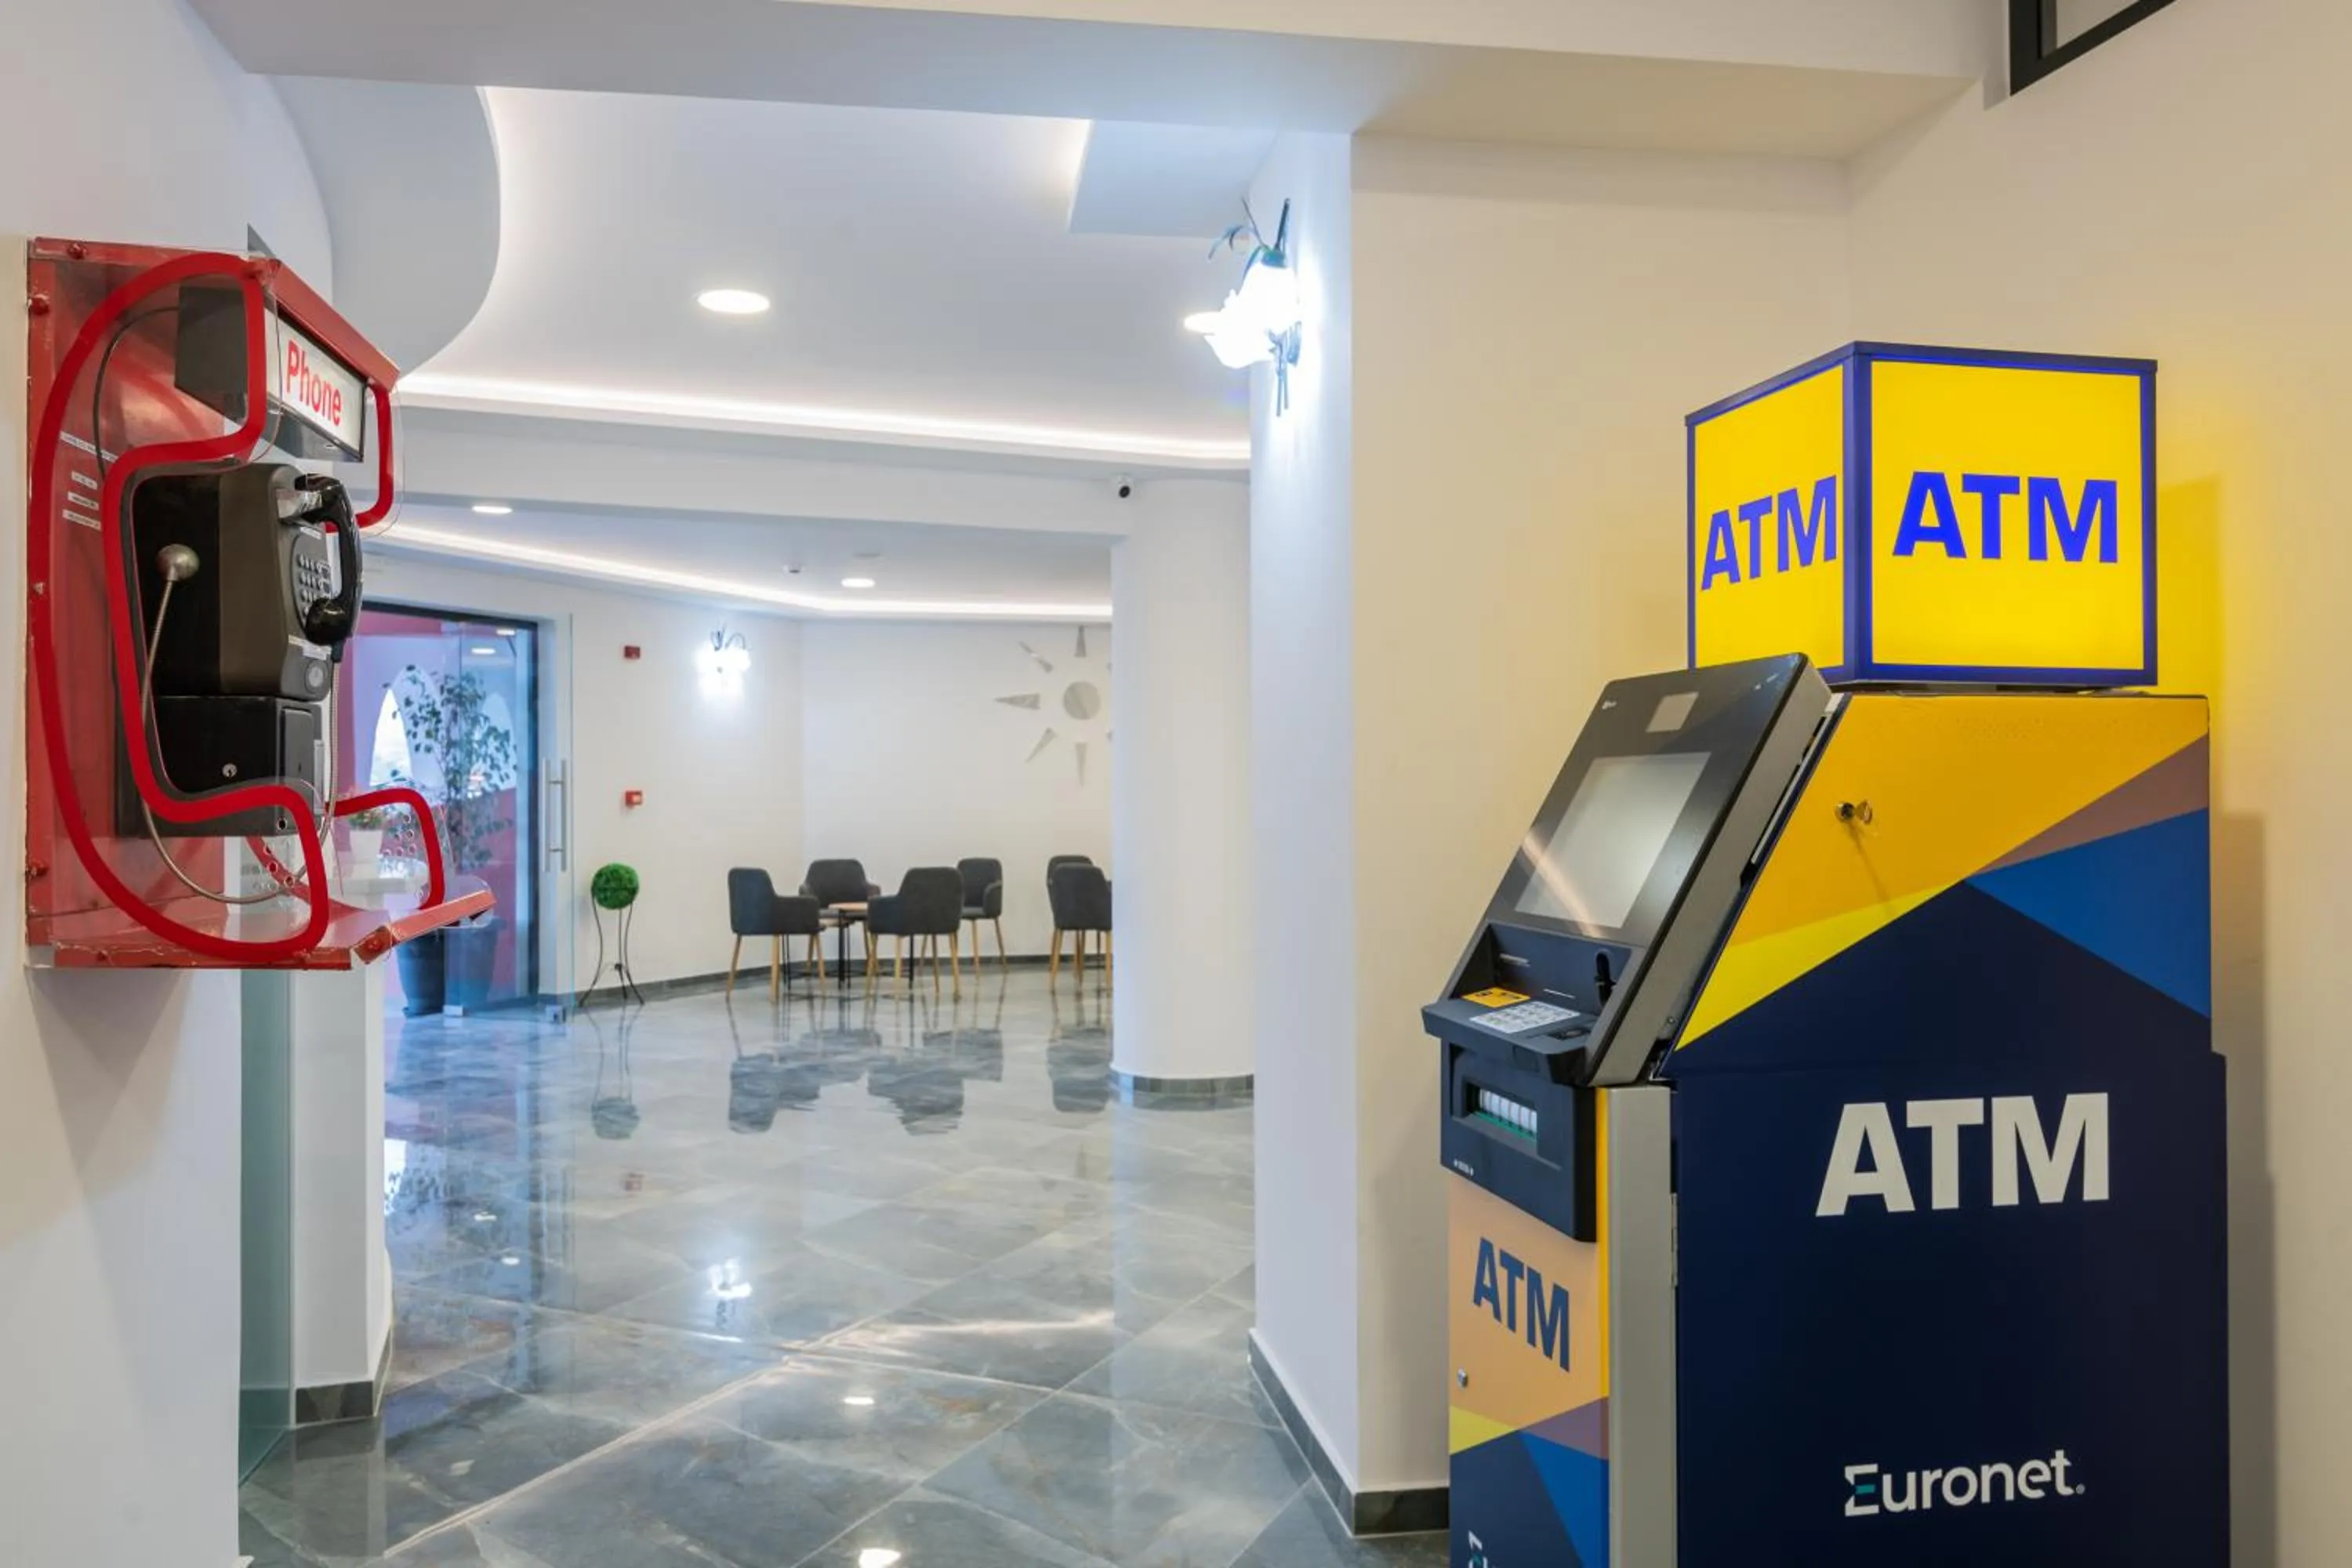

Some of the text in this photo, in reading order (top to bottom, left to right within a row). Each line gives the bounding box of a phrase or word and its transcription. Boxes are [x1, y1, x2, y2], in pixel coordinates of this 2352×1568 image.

[287, 339, 342, 426] Phone
[1701, 474, 1838, 590] ATM
[1894, 471, 2118, 564] ATM
[1816, 1092, 2109, 1217] ATM
[1473, 1237, 1570, 1373] ATM
